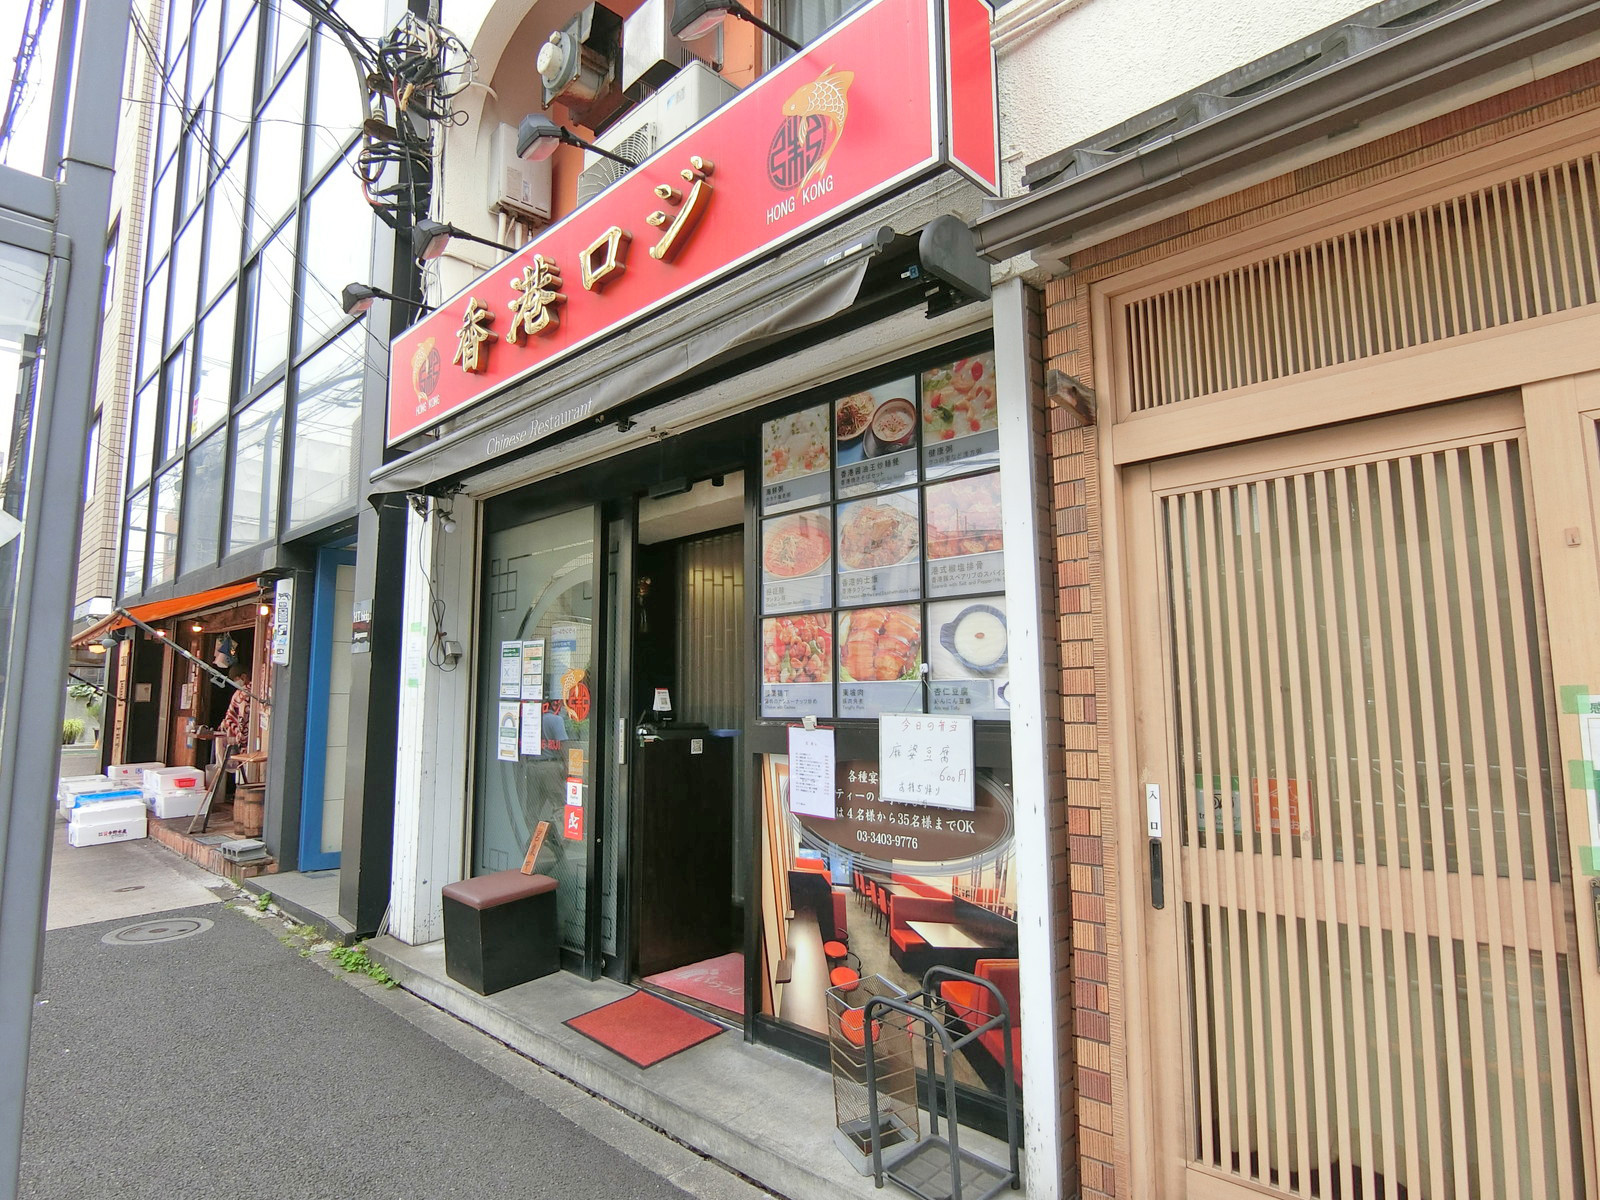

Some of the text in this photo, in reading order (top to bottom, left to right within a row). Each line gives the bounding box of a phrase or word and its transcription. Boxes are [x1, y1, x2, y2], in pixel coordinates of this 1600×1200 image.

[766, 175, 833, 225] HONG KONG
[452, 155, 710, 374] 香港ロジ
[416, 404, 427, 417] HONG
[486, 397, 593, 456] Chinese Restaurant
[934, 687, 968, 696] 杏仁豆腐
[939, 765, 967, 783] 600円
[1149, 790, 1159, 830] 入口
[856, 829, 918, 850] 03-3403-9776
